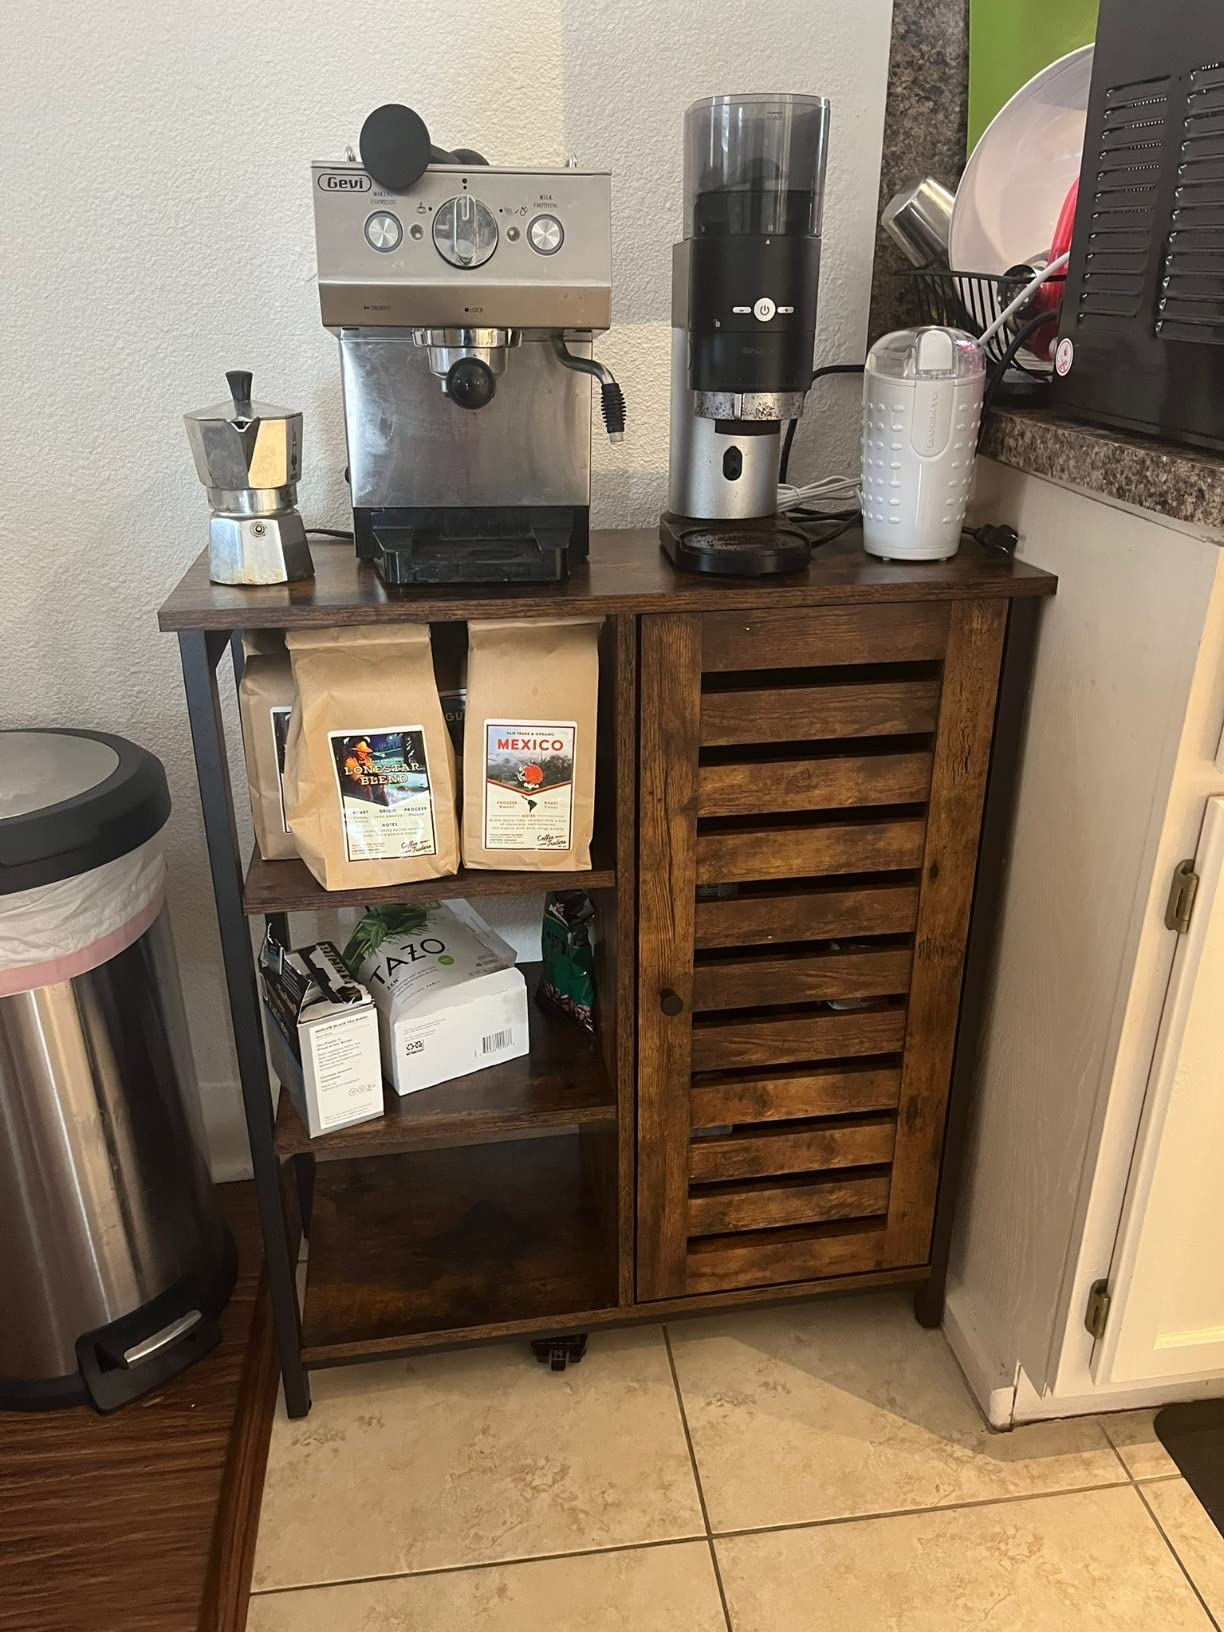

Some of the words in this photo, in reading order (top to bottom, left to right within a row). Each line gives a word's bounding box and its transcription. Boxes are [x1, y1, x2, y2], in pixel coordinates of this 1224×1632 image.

[327, 176, 364, 190] Gevi
[497, 738, 564, 752] MEXICO
[344, 762, 423, 776] LONESTAR
[360, 773, 409, 786] BLEND
[369, 938, 446, 985] TAZO
